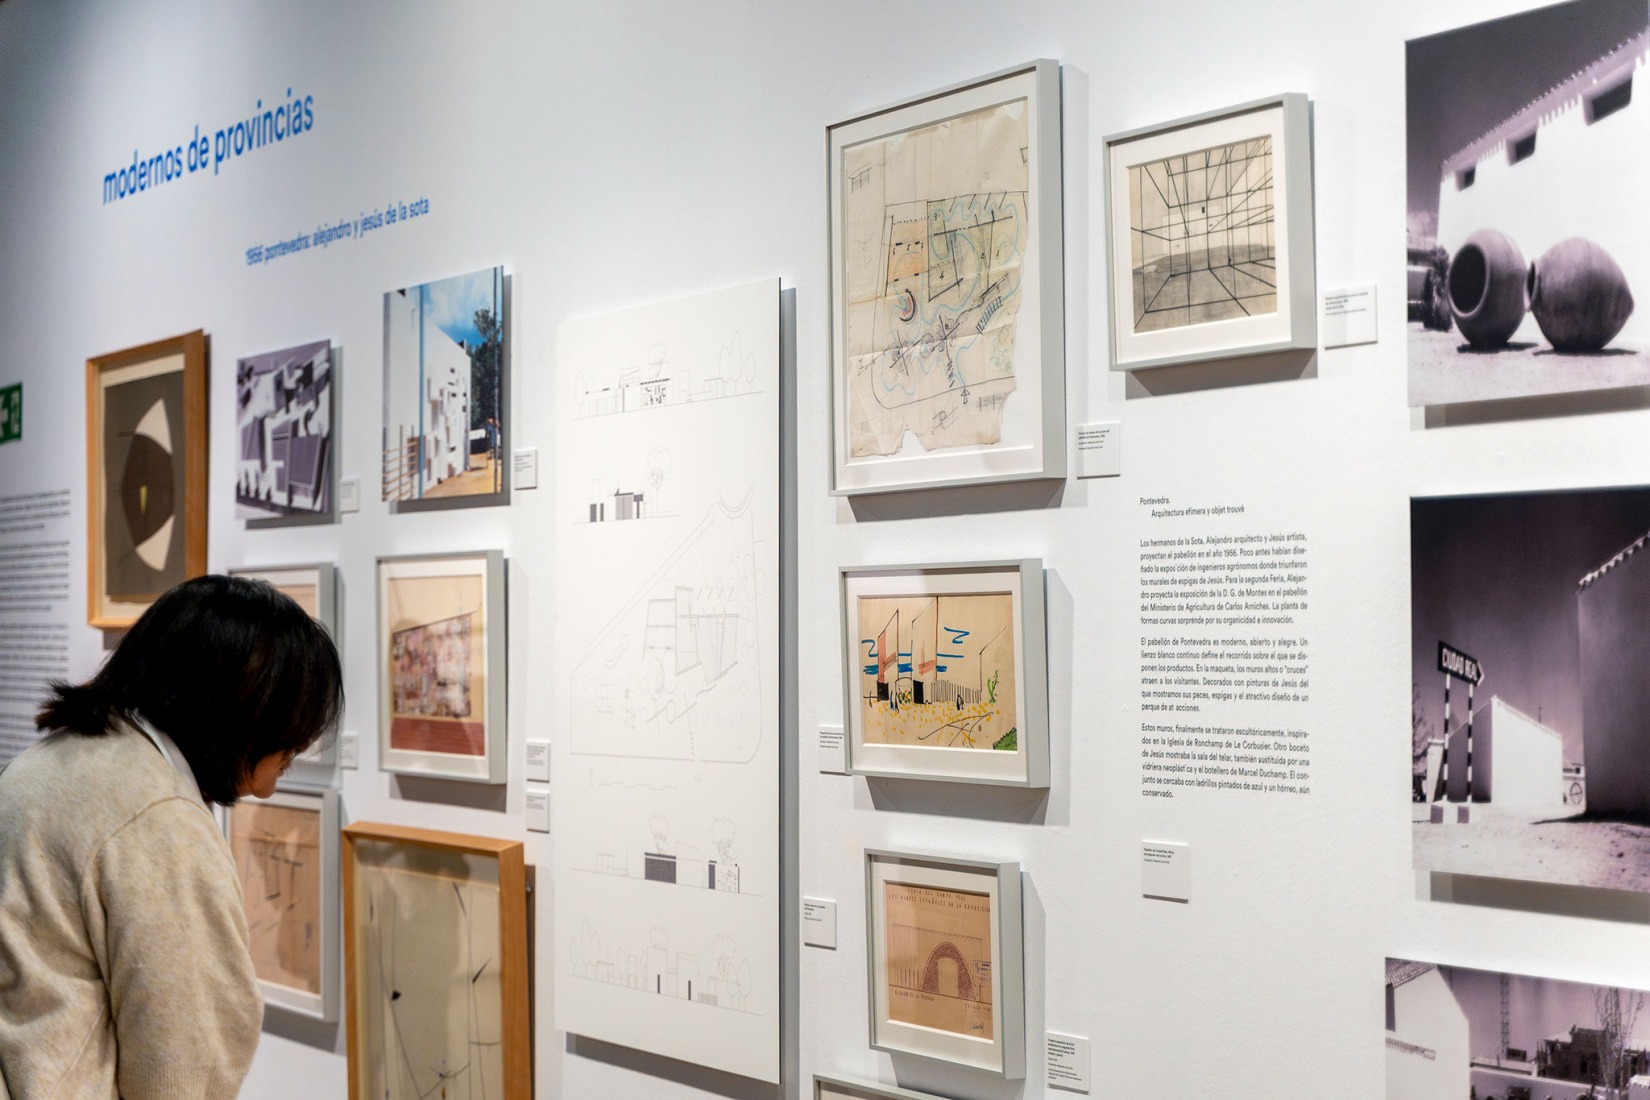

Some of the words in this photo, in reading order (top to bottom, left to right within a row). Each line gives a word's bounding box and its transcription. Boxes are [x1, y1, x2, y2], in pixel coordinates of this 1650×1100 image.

[103, 150, 182, 204] modernos
[187, 125, 209, 173] de
[214, 86, 314, 174] provincias
[313, 220, 352, 248] alejandro
[352, 221, 360, 239] y
[360, 209, 384, 237] jesús
[384, 204, 396, 224] de
[398, 201, 407, 220] la
[410, 196, 430, 218] sota
[1140, 496, 1170, 505] Pontevedra.
[1152, 507, 1184, 518] Arquitectura
[1211, 505, 1226, 516] objet
[1140, 538, 1149, 547] Los
[1150, 537, 1176, 546] hermanos
[1177, 537, 1184, 545] de
[1185, 536, 1190, 545] la
[1206, 535, 1233, 546] Alejandro
[1234, 534, 1263, 545] arquitecto
[1269, 533, 1285, 542] Jesús
[1286, 533, 1307, 542] artista,
[1141, 550, 1167, 561] proyectan
[1174, 549, 1197, 560] pabellón
[1206, 549, 1211, 557] el
[1212, 548, 1223, 557] año
[1224, 548, 1238, 557] 1956.
[1240, 548, 1254, 556] Poco
[1255, 547, 1271, 556] antes
[1293, 546, 1306, 555] dise-
[1141, 564, 1154, 572] ñado
[1160, 563, 1188, 574] exposción
[1189, 562, 1196, 571] de
[1197, 562, 1226, 573] ingenieros
[1227, 561, 1258, 572] agrónomos
[1259, 560, 1277, 569] donde
[1278, 560, 1307, 569] triunfaron
[1149, 576, 1170, 585] murales
[1171, 576, 1177, 584] de
[1178, 576, 1198, 586] espigas
[1199, 575, 1206, 584] de
[1207, 575, 1224, 584] Jesús.
[1225, 575, 1238, 583] Para
[1245, 574, 1269, 585] segunda
[1287, 573, 1307, 584] Alejan-
[1141, 589, 1150, 598] dro
[1150, 589, 1173, 600] proyecta
[1174, 589, 1179, 597] la
[1180, 588, 1208, 599] exposición
[1209, 588, 1216, 597] de
[1217, 588, 1222, 597] la
[1238, 588, 1245, 596] de
[1246, 588, 1267, 596] Montes
[1276, 588, 1282, 596] el
[1283, 587, 1308, 598] pabellón
[1141, 602, 1149, 611] del
[1150, 602, 1176, 611] Ministerio
[1177, 602, 1184, 611] de
[1186, 602, 1215, 612] Agricultura
[1217, 602, 1224, 610] de
[1225, 602, 1243, 610] Carlos
[1244, 602, 1270, 610] Arniches.
[1272, 601, 1279, 610] La
[1281, 601, 1299, 612] planta
[1300, 601, 1308, 610] de
[1141, 615, 1159, 624] formas
[1178, 615, 1204, 625] sorprende
[1206, 617, 1215, 625] por
[1223, 615, 1256, 625] organicidad
[1262, 615, 1294, 623] innovación.
[1141, 637, 1147, 645] El
[1148, 637, 1171, 647] pabellón
[1172, 637, 1179, 646] de
[1181, 637, 1211, 646] Pontevedra
[1221, 637, 1248, 646] moderno,
[1250, 637, 1271, 646] abierto
[1278, 637, 1297, 648] alegre.
[1300, 637, 1308, 646] Un
[1141, 650, 1157, 658] lienzo
[1158, 650, 1175, 659] blanco
[1201, 650, 1218, 659] define
[1220, 651, 1225, 659] el
[1226, 651, 1252, 659] recorrido
[1253, 651, 1269, 659] sobre
[1270, 651, 1276, 660] el
[1277, 654, 1288, 662] que
[1298, 651, 1308, 660] dis-
[1141, 665, 1158, 673] ponen
[1167, 663, 1195, 674] productos.
[1196, 664, 1203, 672] En
[1204, 664, 1209, 672] la
[1210, 664, 1236, 674] maqueta,
[1237, 664, 1245, 673] los
[1265, 665, 1279, 673] altos
[1142, 676, 1158, 685] atraen
[1174, 677, 1200, 686] visitantes.
[1203, 677, 1232, 686] Decorados
[1246, 678, 1270, 689] pinturas
[1272, 678, 1279, 687] de
[1281, 679, 1297, 687] Jesús
[1299, 679, 1309, 688] del
[1142, 692, 1151, 700] que
[1153, 689, 1182, 698] mostramos
[1193, 693, 1210, 701] peces,
[1212, 691, 1232, 701] espigas
[1239, 691, 1244, 700] el
[1246, 691, 1270, 700] atractivo
[1272, 692, 1291, 701] diseño
[1292, 692, 1300, 701] de
[1142, 704, 1160, 712] parque
[1161, 702, 1168, 711] de
